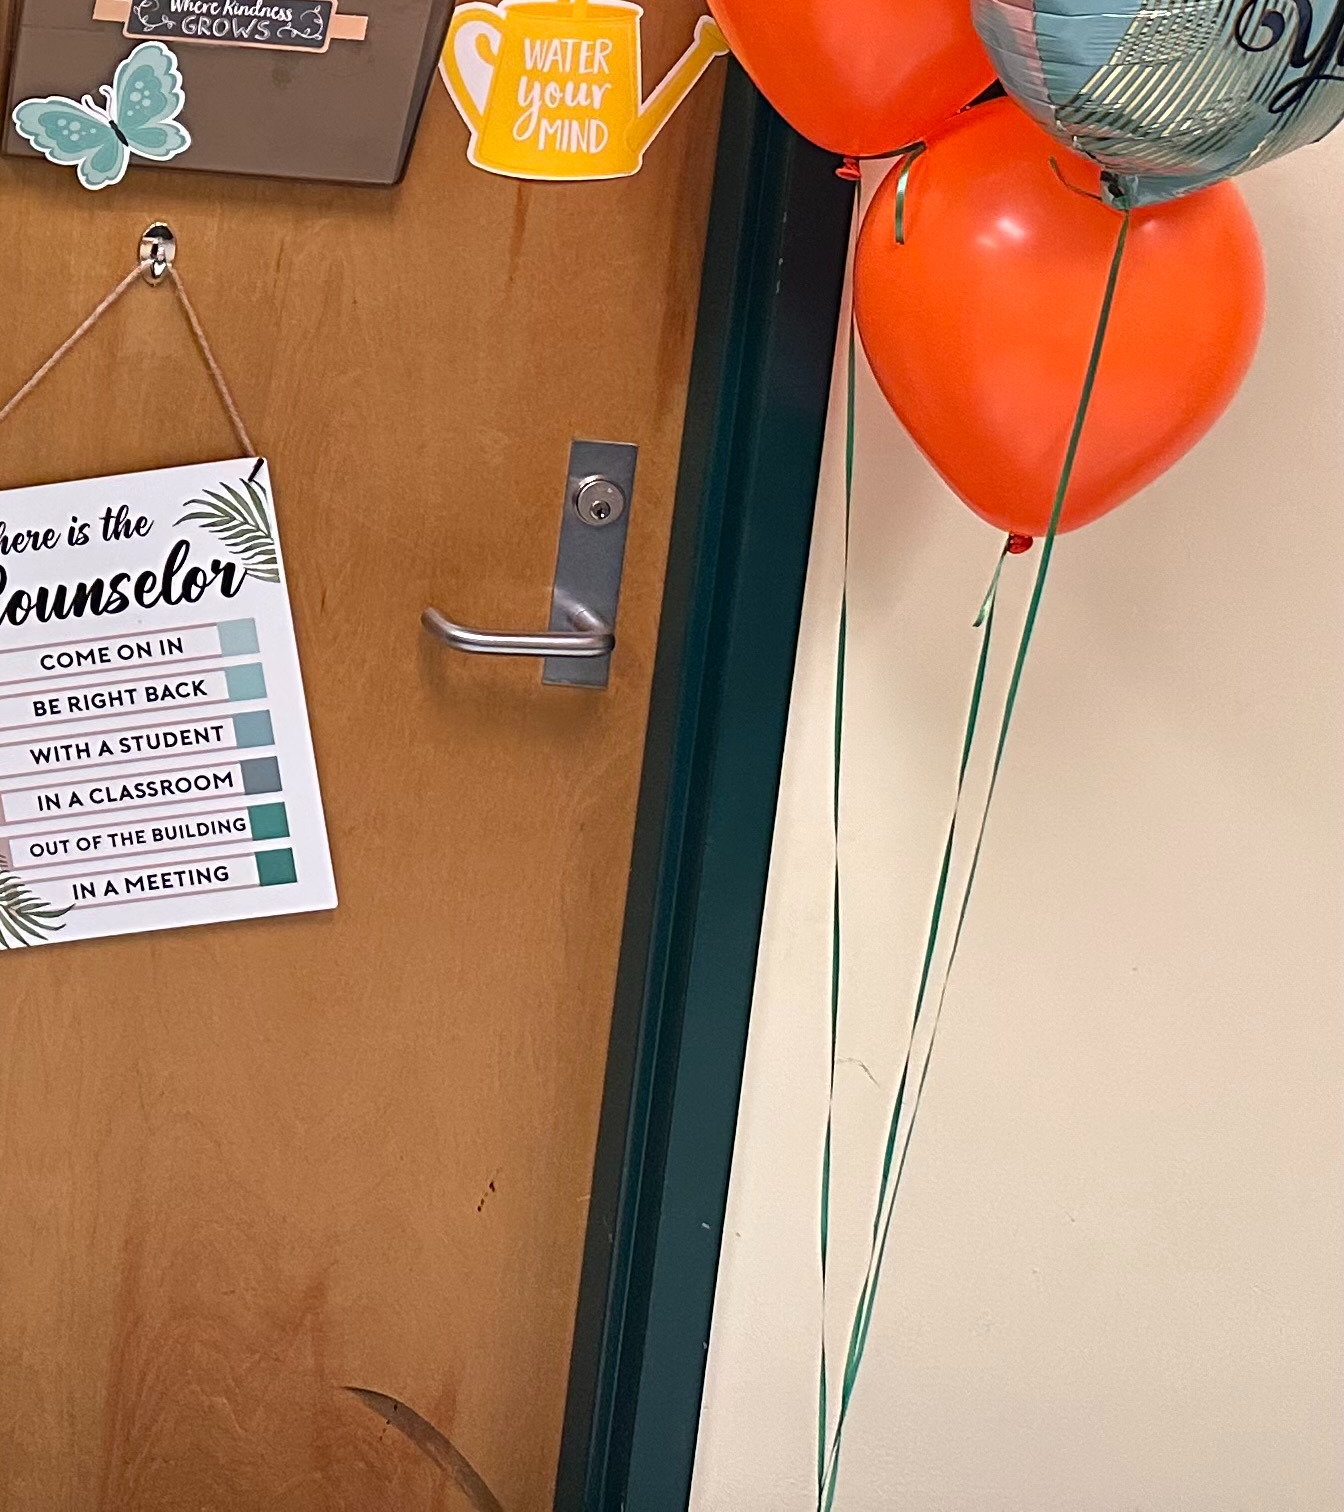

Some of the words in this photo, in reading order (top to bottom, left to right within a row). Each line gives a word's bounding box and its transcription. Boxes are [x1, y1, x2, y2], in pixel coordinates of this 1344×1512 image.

[181, 15, 271, 40] GROWS
[524, 37, 613, 74] WATER
[512, 75, 613, 142] your
[538, 118, 609, 154] MIND
[67, 515, 91, 547] is
[99, 504, 154, 542] the
[40, 646, 111, 670] COME
[117, 641, 152, 661] ON
[159, 637, 184, 656] IN
[32, 698, 62, 717] BE
[67, 688, 137, 713] RIGHT
[144, 679, 208, 703] BACK
[30, 742, 91, 765] WITH
[98, 740, 114, 757] A
[119, 725, 223, 753] STUDENT
[37, 793, 61, 812] IN
[68, 791, 84, 808] A
[89, 771, 234, 804] CLASSROOM
[29, 839, 70, 858] OUT
[76, 835, 102, 851] OF
[107, 829, 147, 848] THE
[151, 817, 247, 842] BUILDING
[72, 881, 96, 900] IN
[103, 880, 119, 897] A
[124, 865, 229, 894] MEETING
